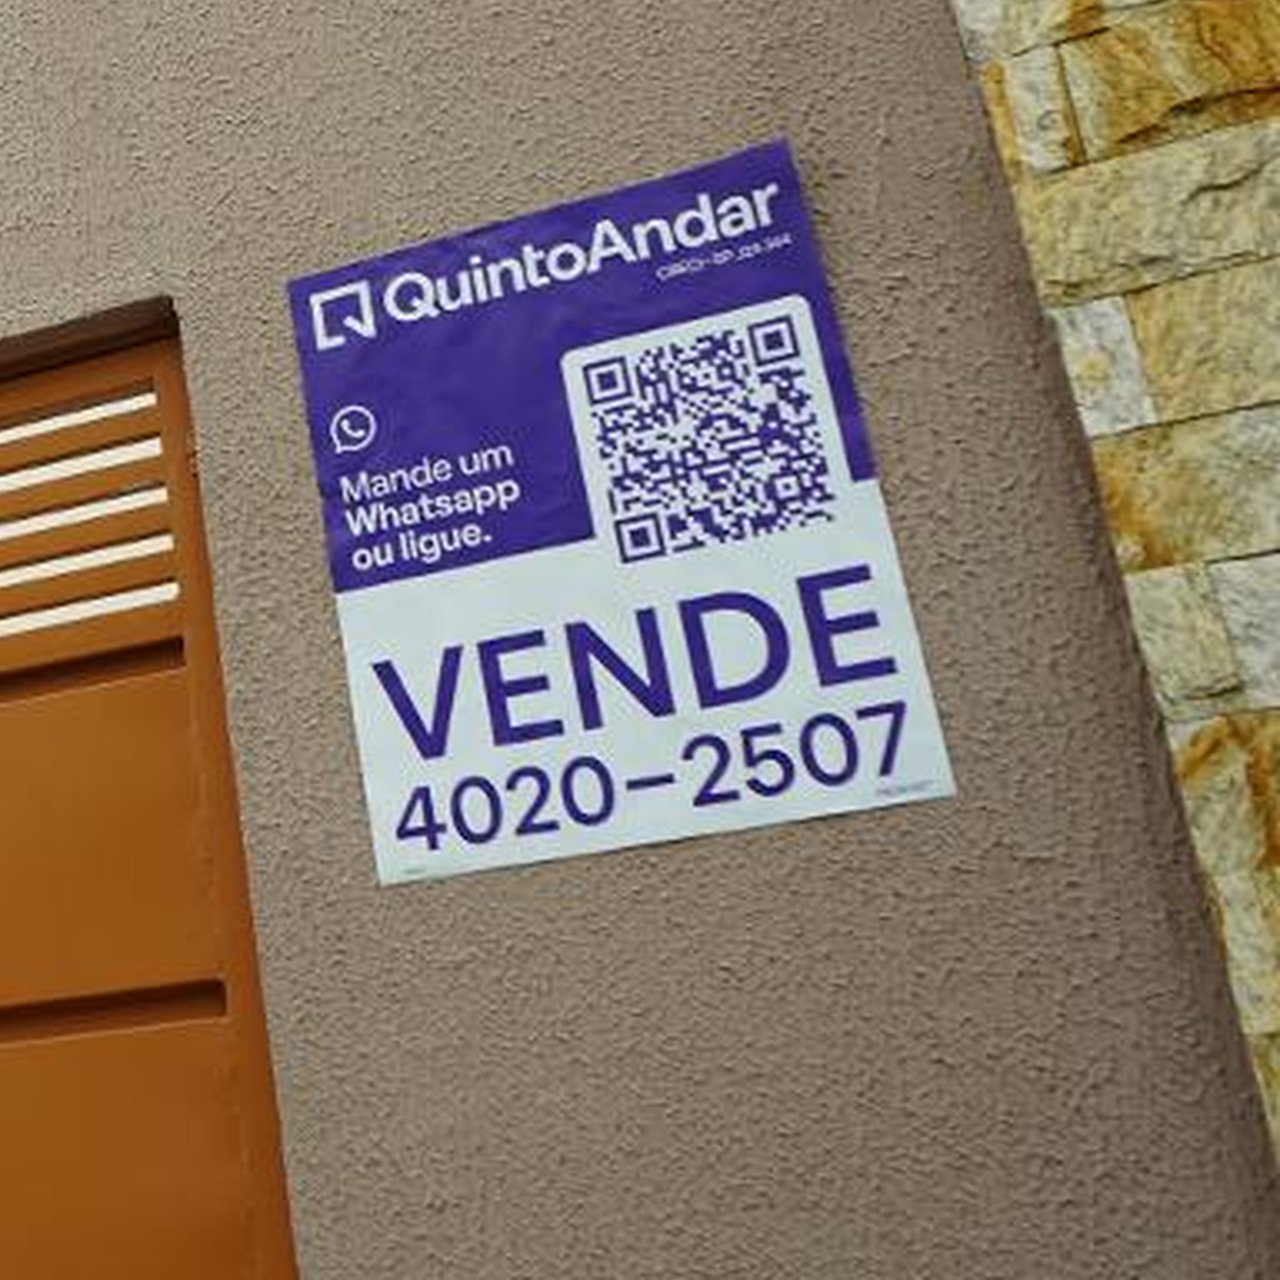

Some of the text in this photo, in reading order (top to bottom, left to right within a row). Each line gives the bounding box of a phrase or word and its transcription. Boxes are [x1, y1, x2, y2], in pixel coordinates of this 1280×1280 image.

[382, 182, 780, 323] QuintoAndar
[341, 444, 515, 504] Mande um
[344, 478, 521, 537] Whatsapp
[351, 523, 493, 571] ou ligue.
[371, 563, 899, 762] VENDE
[394, 700, 908, 853] 4020-2507
